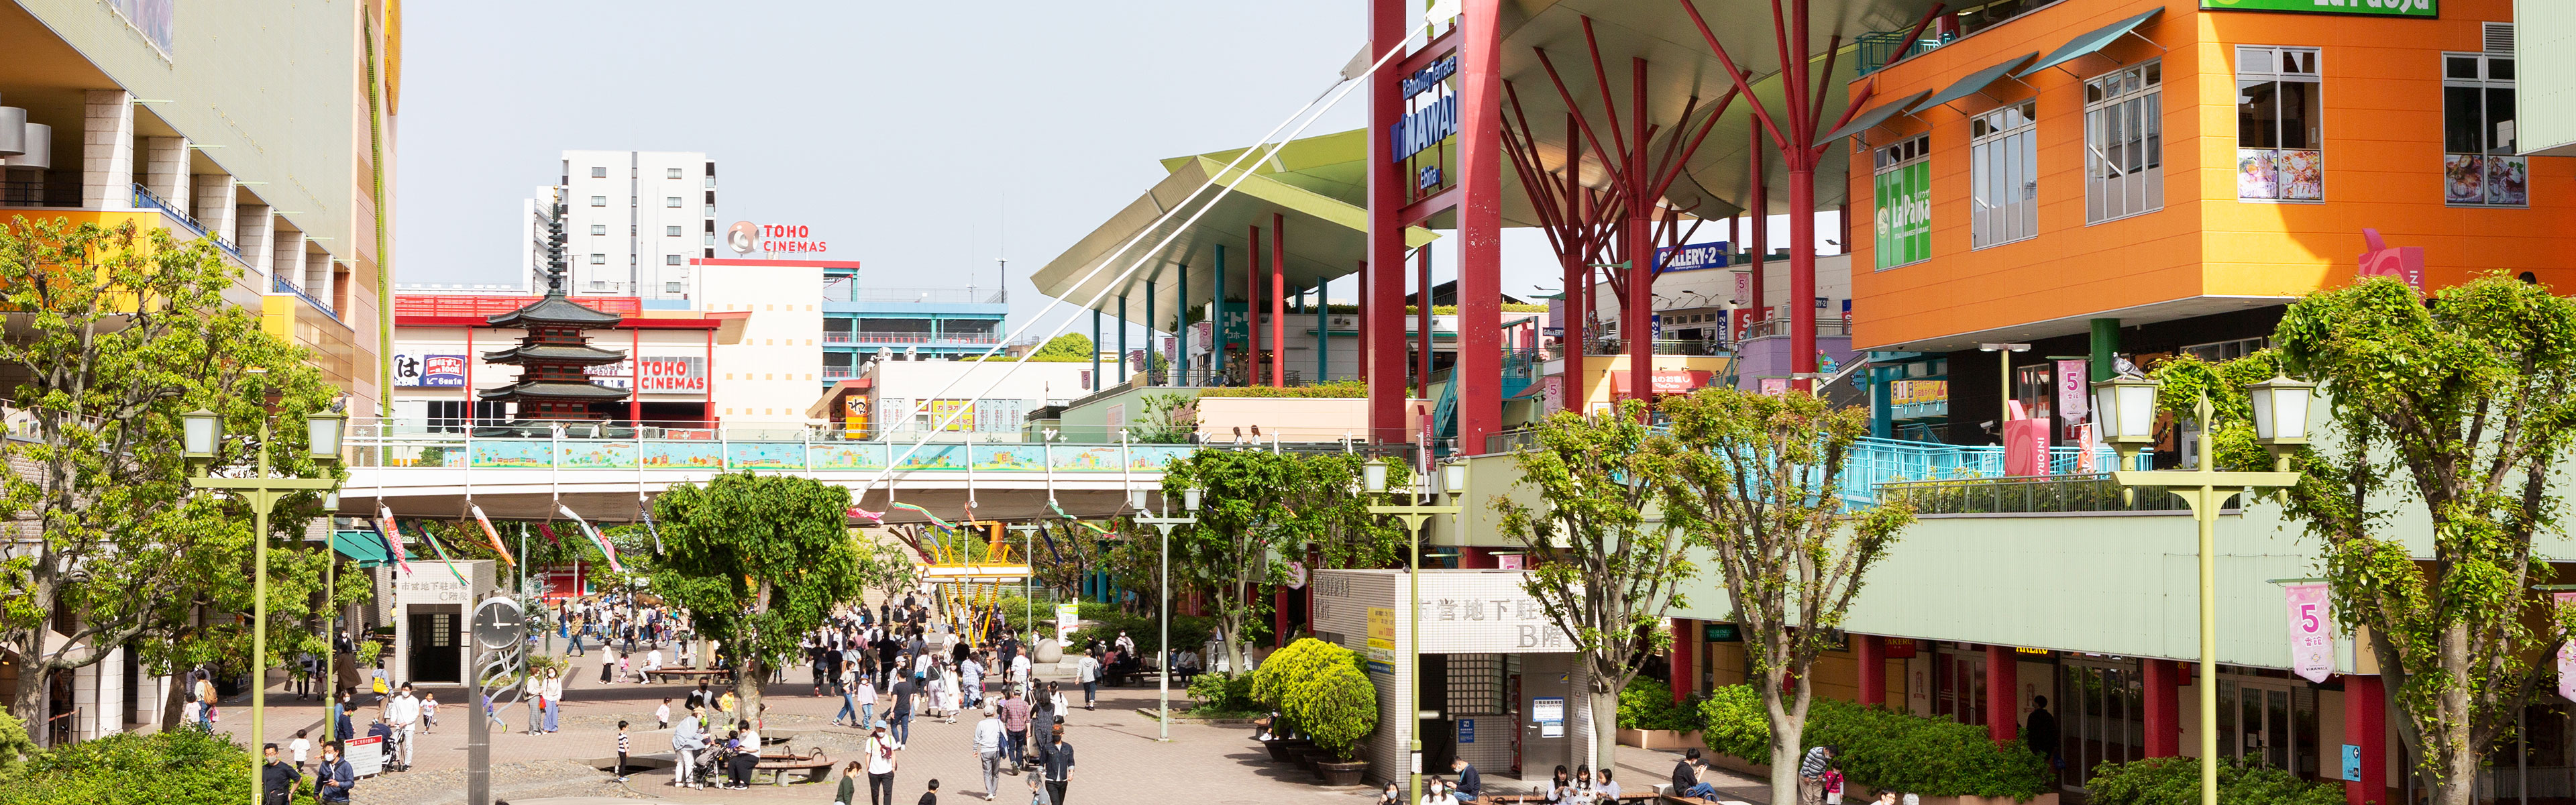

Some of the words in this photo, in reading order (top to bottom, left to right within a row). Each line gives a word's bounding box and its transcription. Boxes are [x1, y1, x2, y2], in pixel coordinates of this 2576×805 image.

[1403, 69, 1433, 100] Rambling
[1431, 56, 1456, 83] Terrace
[1420, 166, 1440, 189] Ebina
[763, 225, 808, 237] TOHO
[763, 241, 826, 252] CINEMAS
[1739, 279, 1745, 288] 5
[1203, 328, 1208, 336] 5
[398, 358, 419, 377] は
[641, 361, 687, 375] TOHO
[641, 377, 704, 389] CINEMAS
[2067, 373, 2078, 390] 5
[1550, 384, 1557, 395] 5
[2300, 604, 2319, 633] 5
